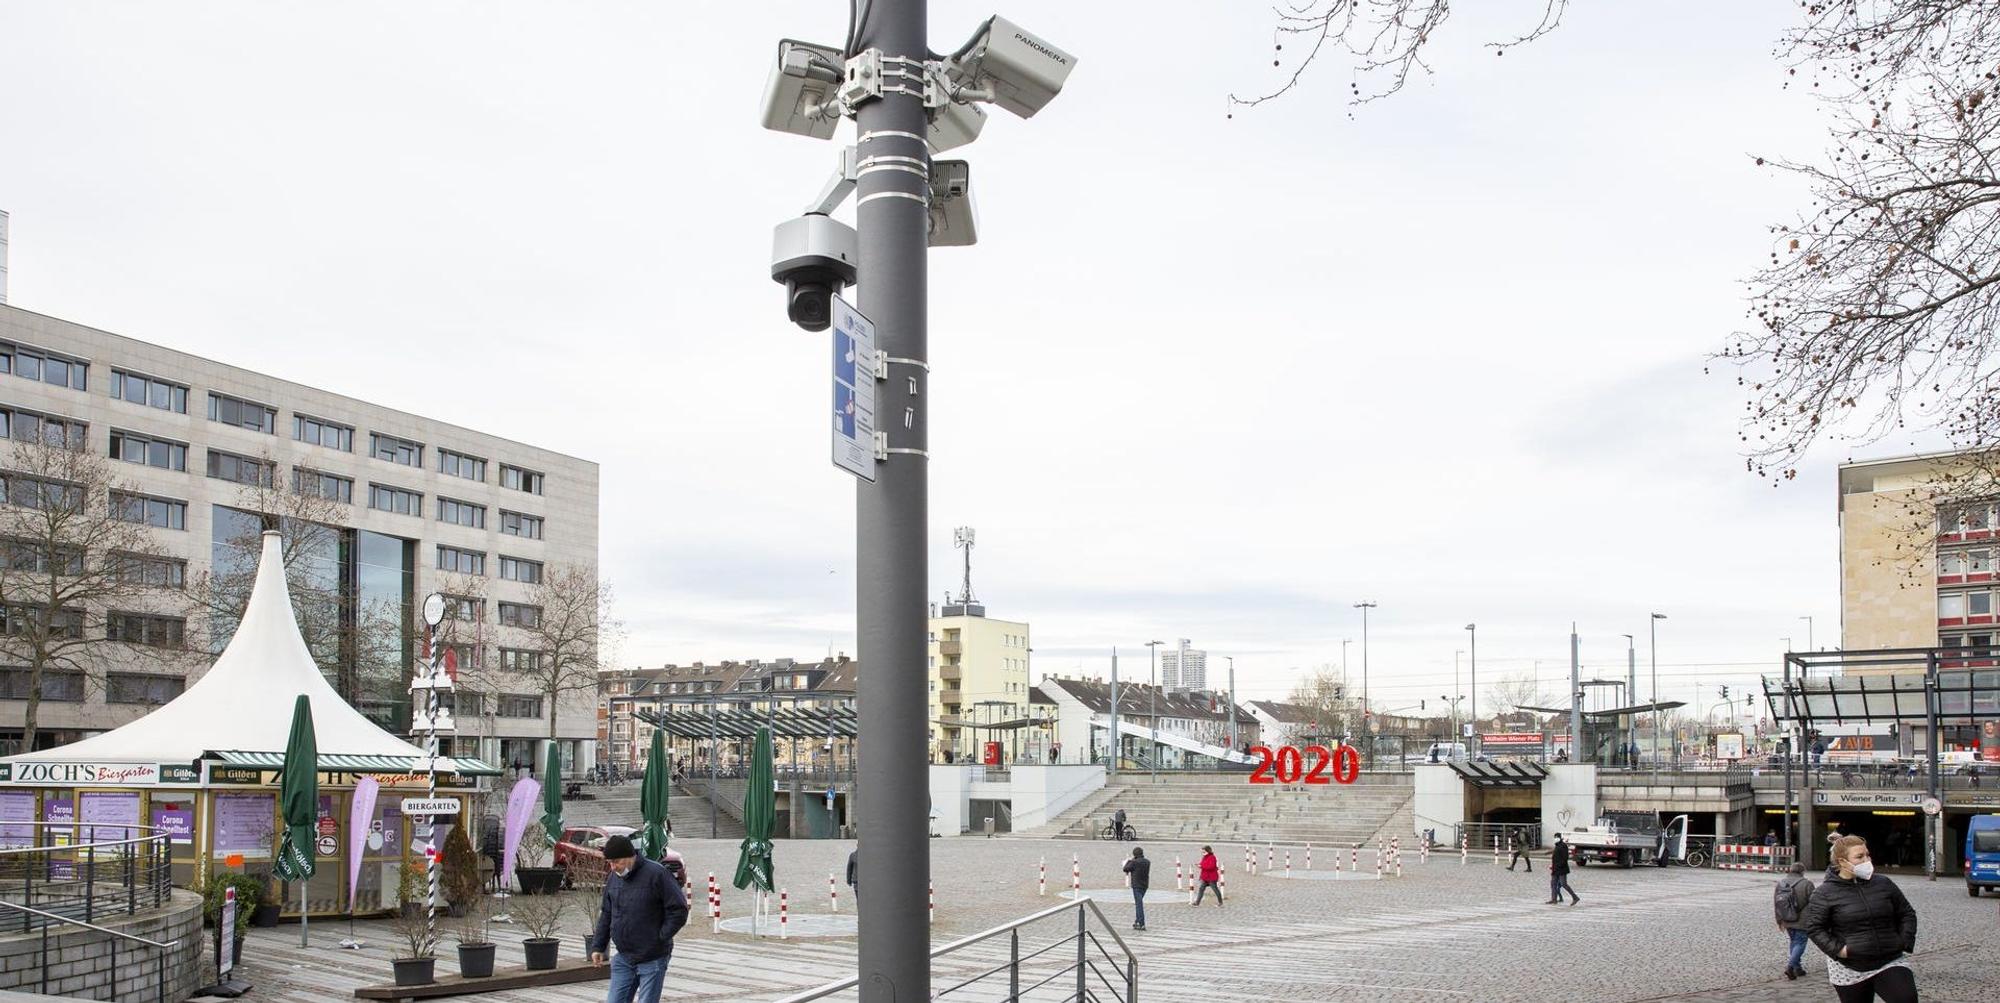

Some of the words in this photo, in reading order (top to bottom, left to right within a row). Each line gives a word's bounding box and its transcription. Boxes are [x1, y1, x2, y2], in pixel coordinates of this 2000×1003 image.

[1014, 33, 1066, 65] PANOMERA
[1846, 736, 1873, 750] AWB
[1249, 744, 1360, 785] 2020
[19, 764, 96, 782] ZOCH'S
[97, 765, 155, 784] Biergarten
[227, 769, 257, 779] Gilden
[1840, 794, 1872, 803] Wiener
[1875, 794, 1896, 803] Platz
[53, 804, 73, 814] Corona
[408, 802, 456, 811] BIERGARTEN
[162, 815, 183, 825] Corona
